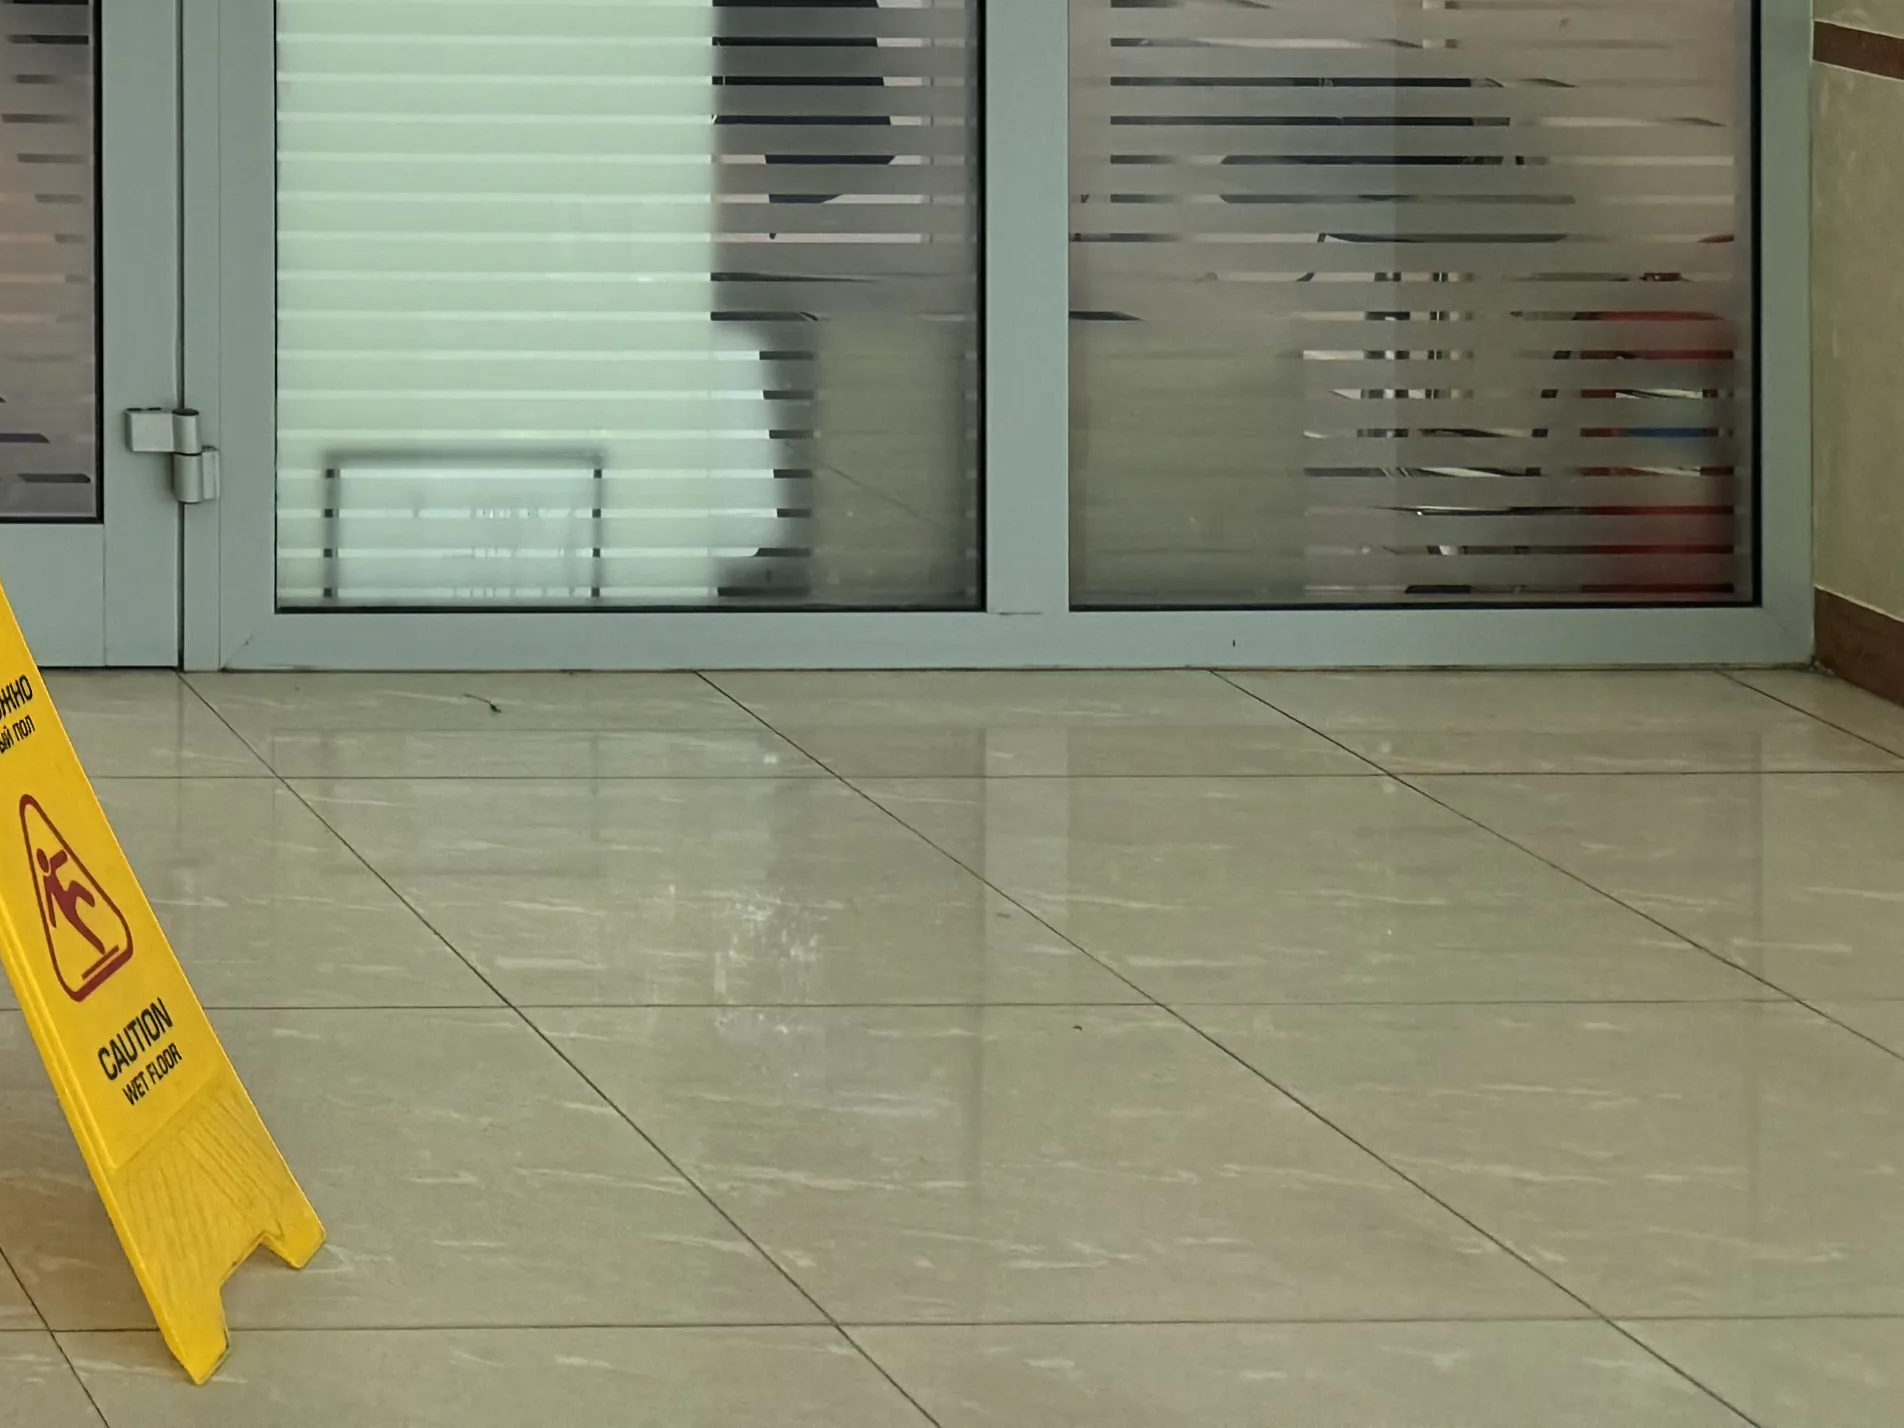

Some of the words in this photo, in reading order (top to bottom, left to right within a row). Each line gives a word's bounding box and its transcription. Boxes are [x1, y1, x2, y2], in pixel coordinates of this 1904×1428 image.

[12, 714, 36, 742] ПОЛ
[97, 996, 173, 1081] CAUTION
[122, 1071, 150, 1106] WET
[145, 1042, 183, 1085] FLOOR
